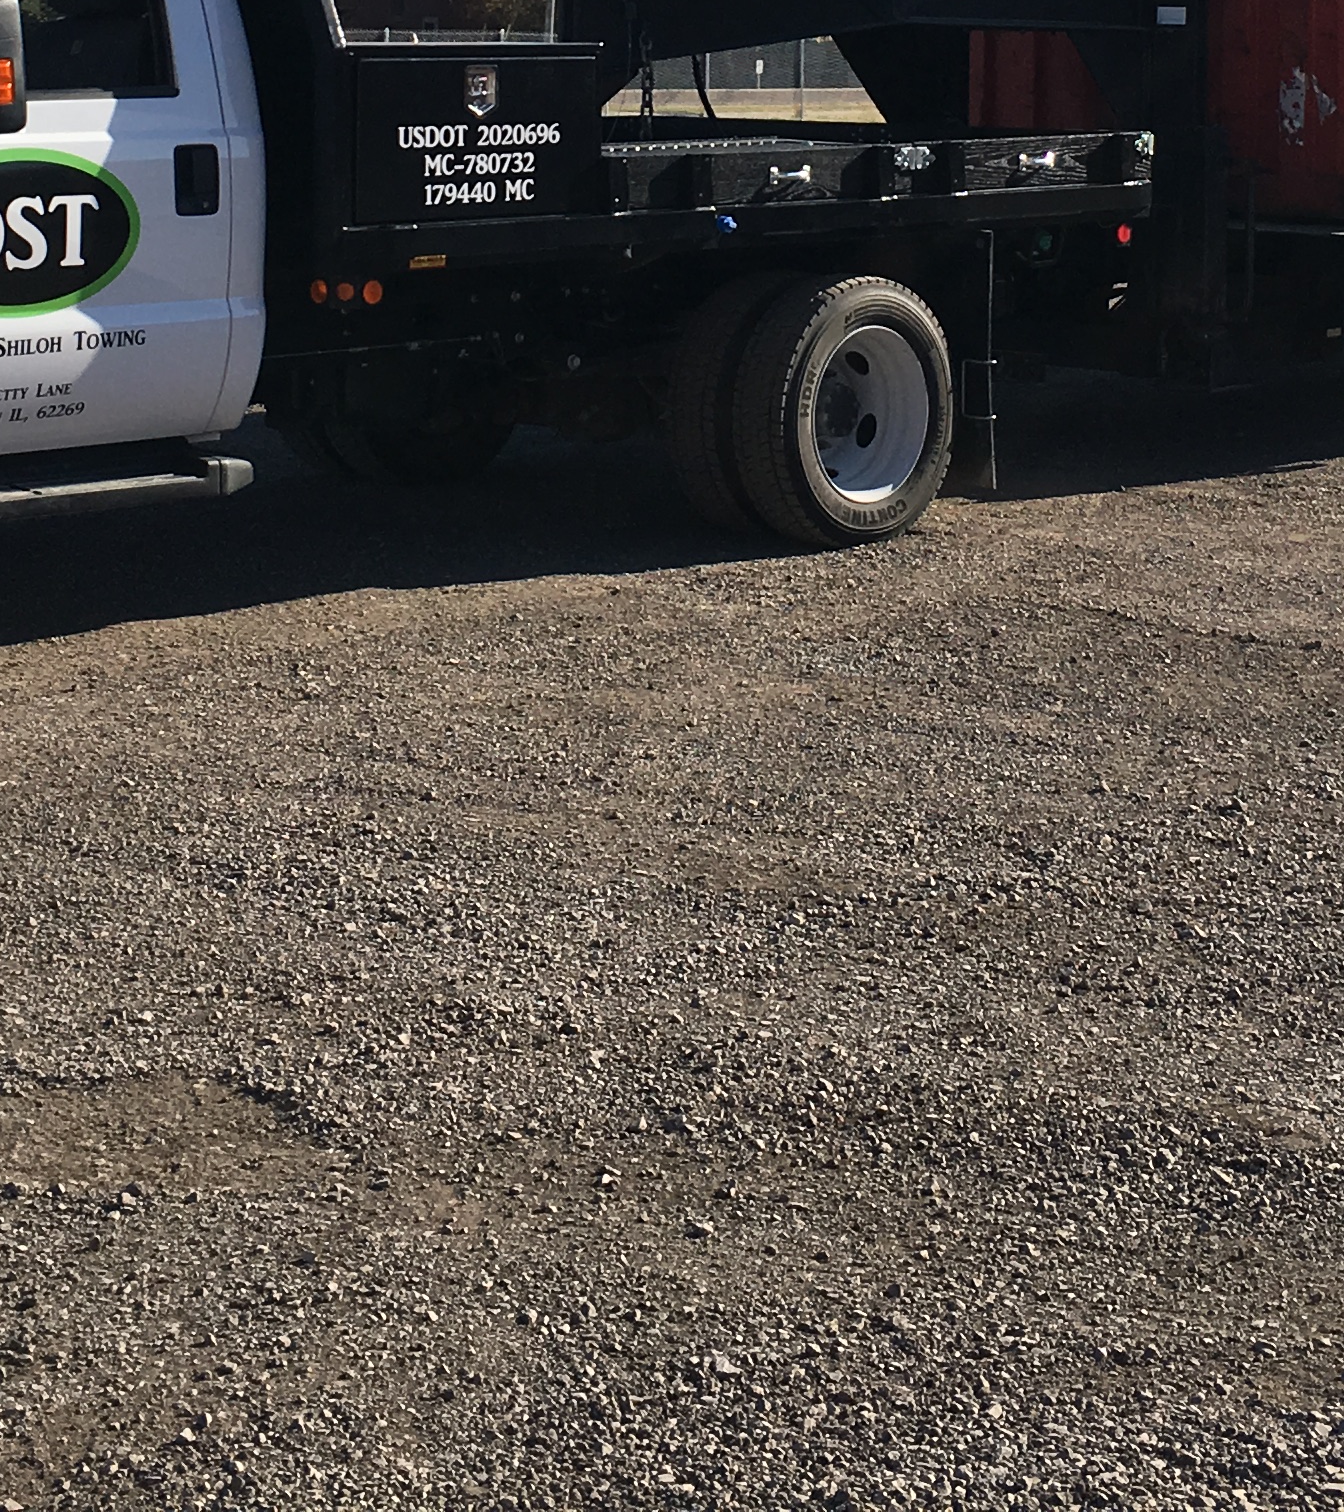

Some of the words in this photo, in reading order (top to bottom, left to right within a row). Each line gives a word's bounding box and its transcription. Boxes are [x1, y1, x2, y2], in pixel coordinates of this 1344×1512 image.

[398, 125, 468, 148] USDOT
[477, 123, 561, 146] 2020696
[424, 152, 535, 176] MC-780732
[424, 182, 496, 205] 179440
[505, 179, 534, 201] MC
[73, 329, 146, 352] TOWING
[36, 382, 72, 399] LANE
[9, 408, 29, 423] IL,
[36, 401, 85, 420] 62269
